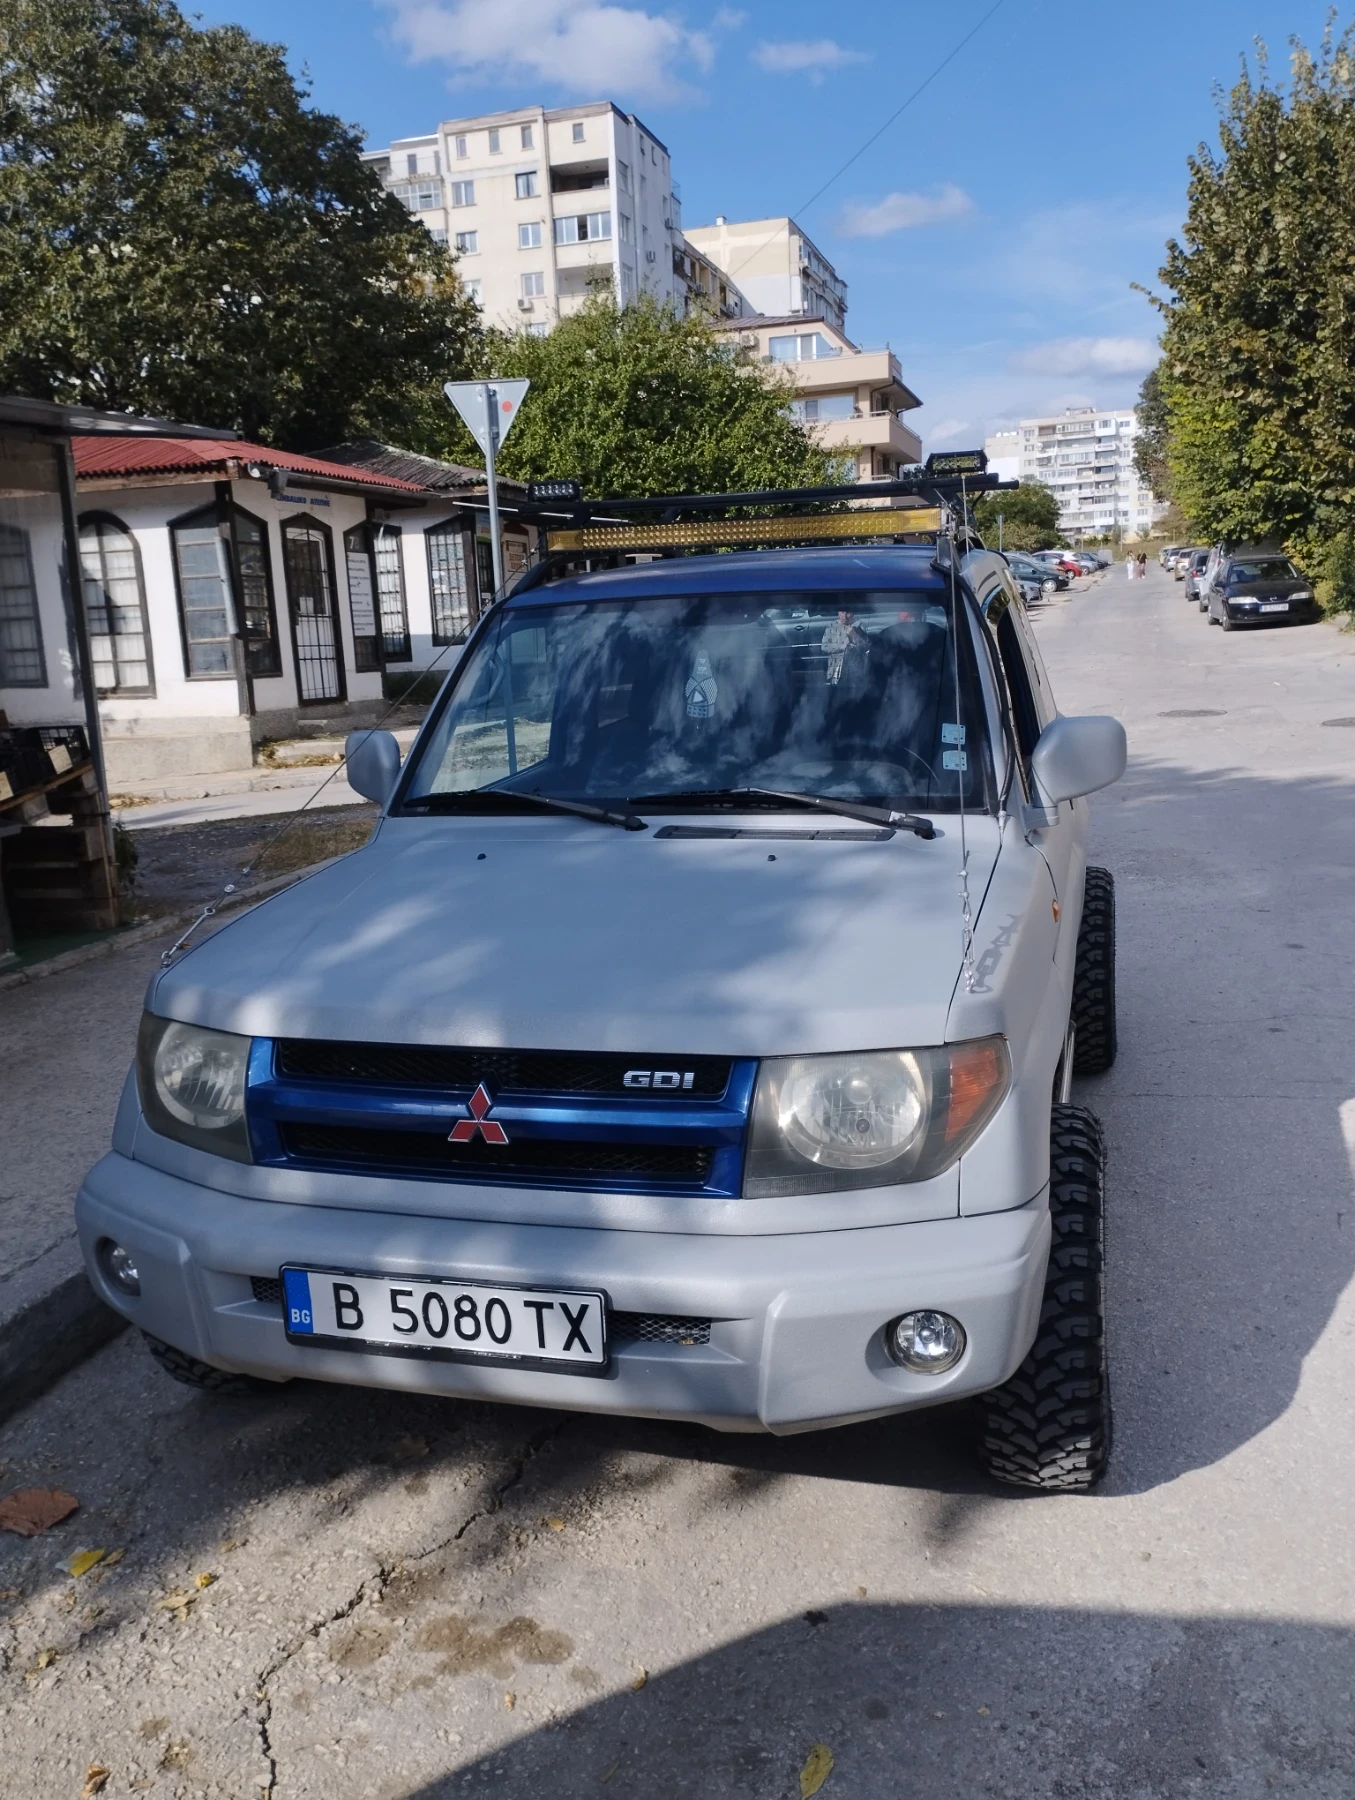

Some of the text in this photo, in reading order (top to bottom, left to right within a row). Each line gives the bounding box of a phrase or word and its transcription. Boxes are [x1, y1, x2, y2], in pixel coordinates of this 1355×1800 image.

[623, 1070, 695, 1089] GDI
[291, 1308, 311, 1324] BG
[332, 1281, 593, 1354] B 5080 TX
